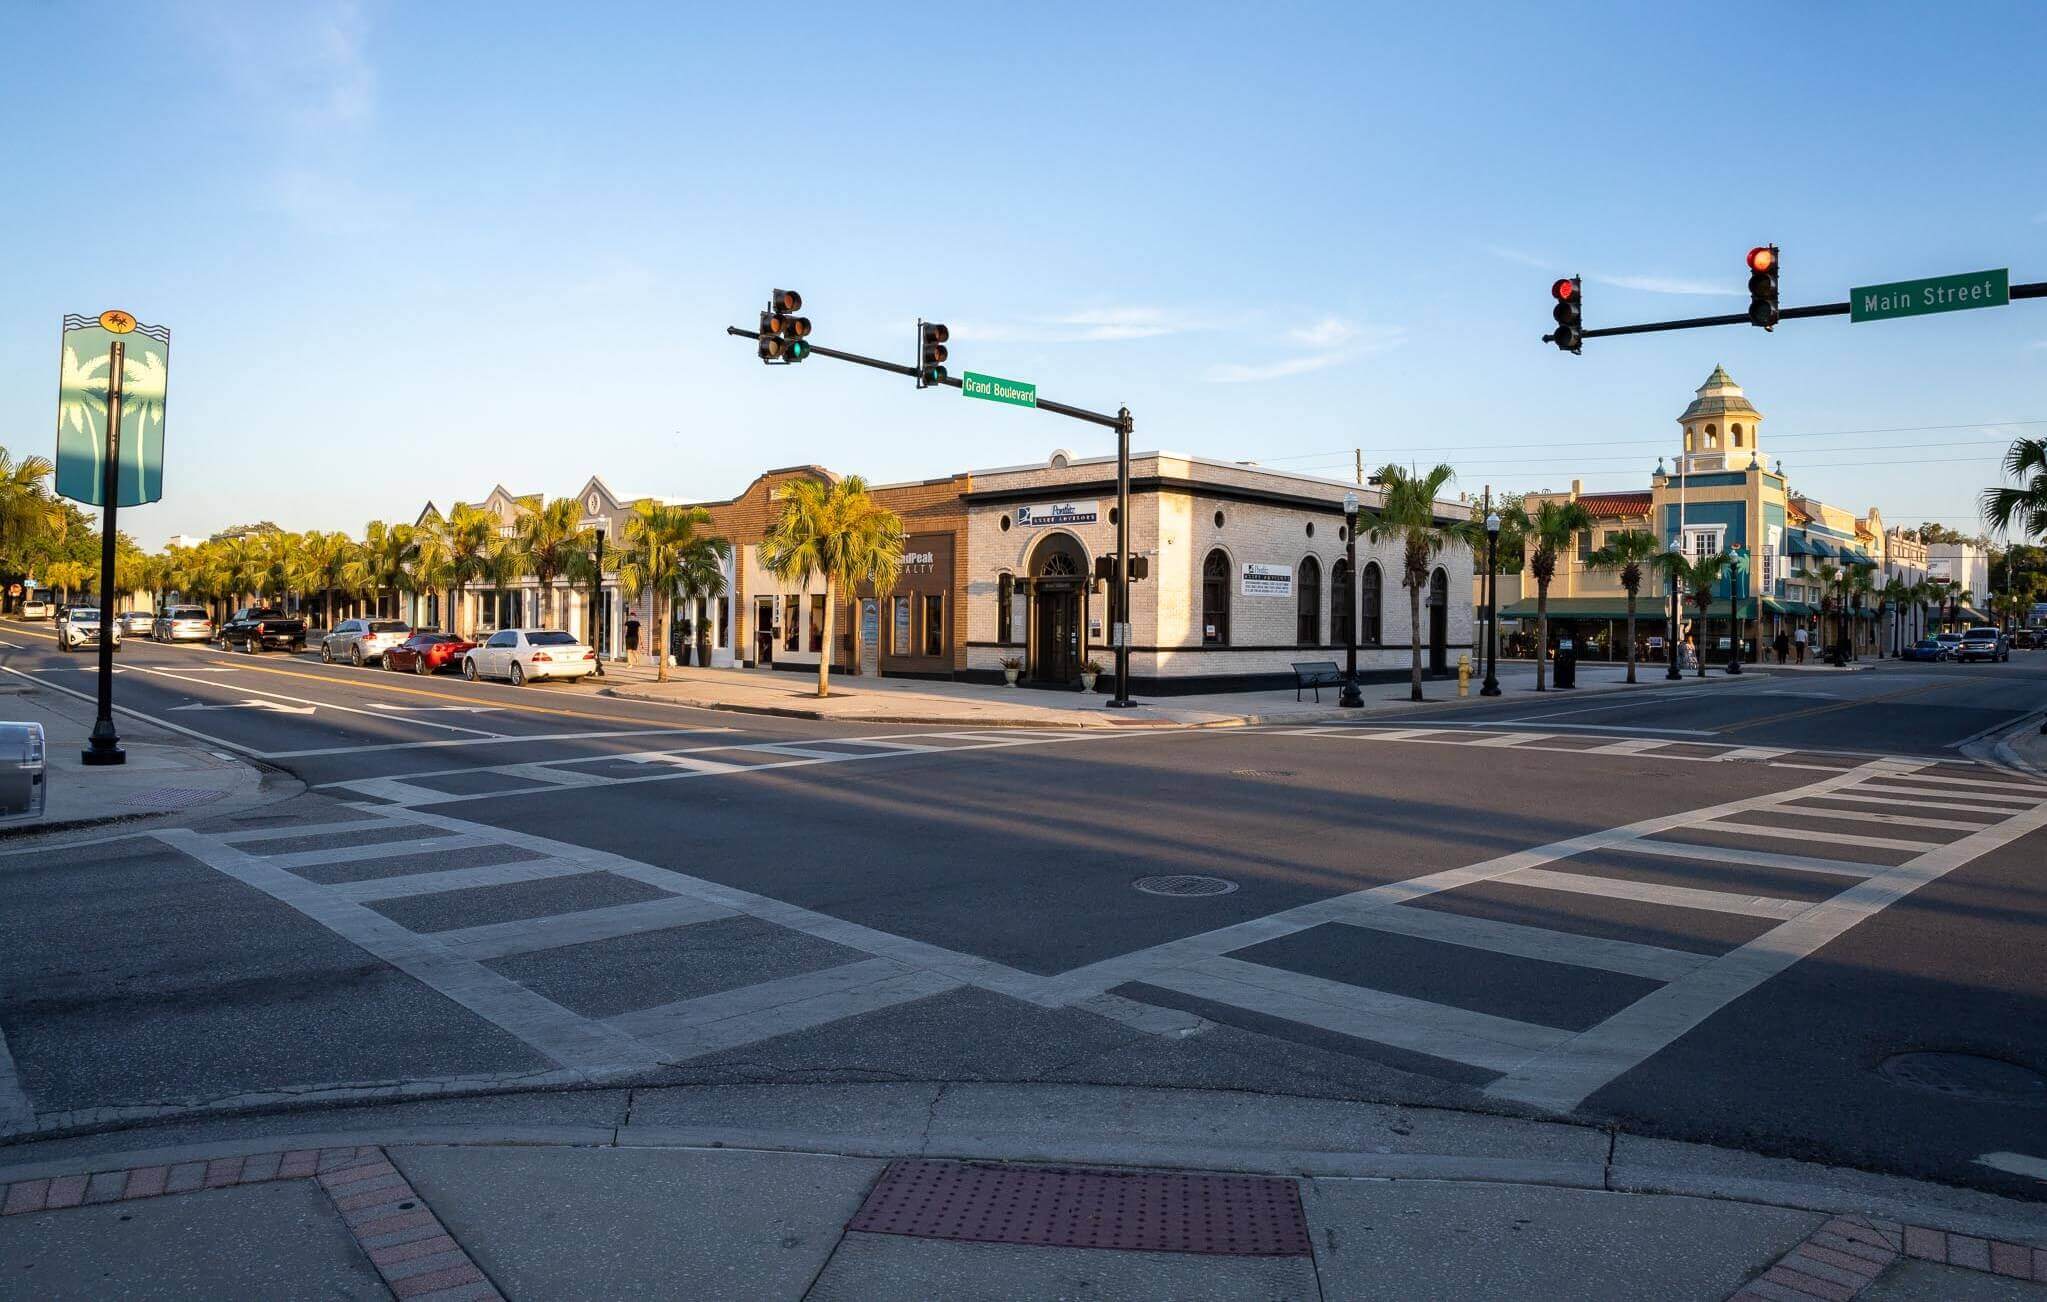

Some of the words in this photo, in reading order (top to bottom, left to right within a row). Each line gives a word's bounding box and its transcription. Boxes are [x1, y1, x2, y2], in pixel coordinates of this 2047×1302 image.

[1865, 292, 1911, 313] Main
[1923, 280, 1993, 306] Street
[966, 378, 991, 395] Grand
[993, 383, 1035, 403] Boulevard
